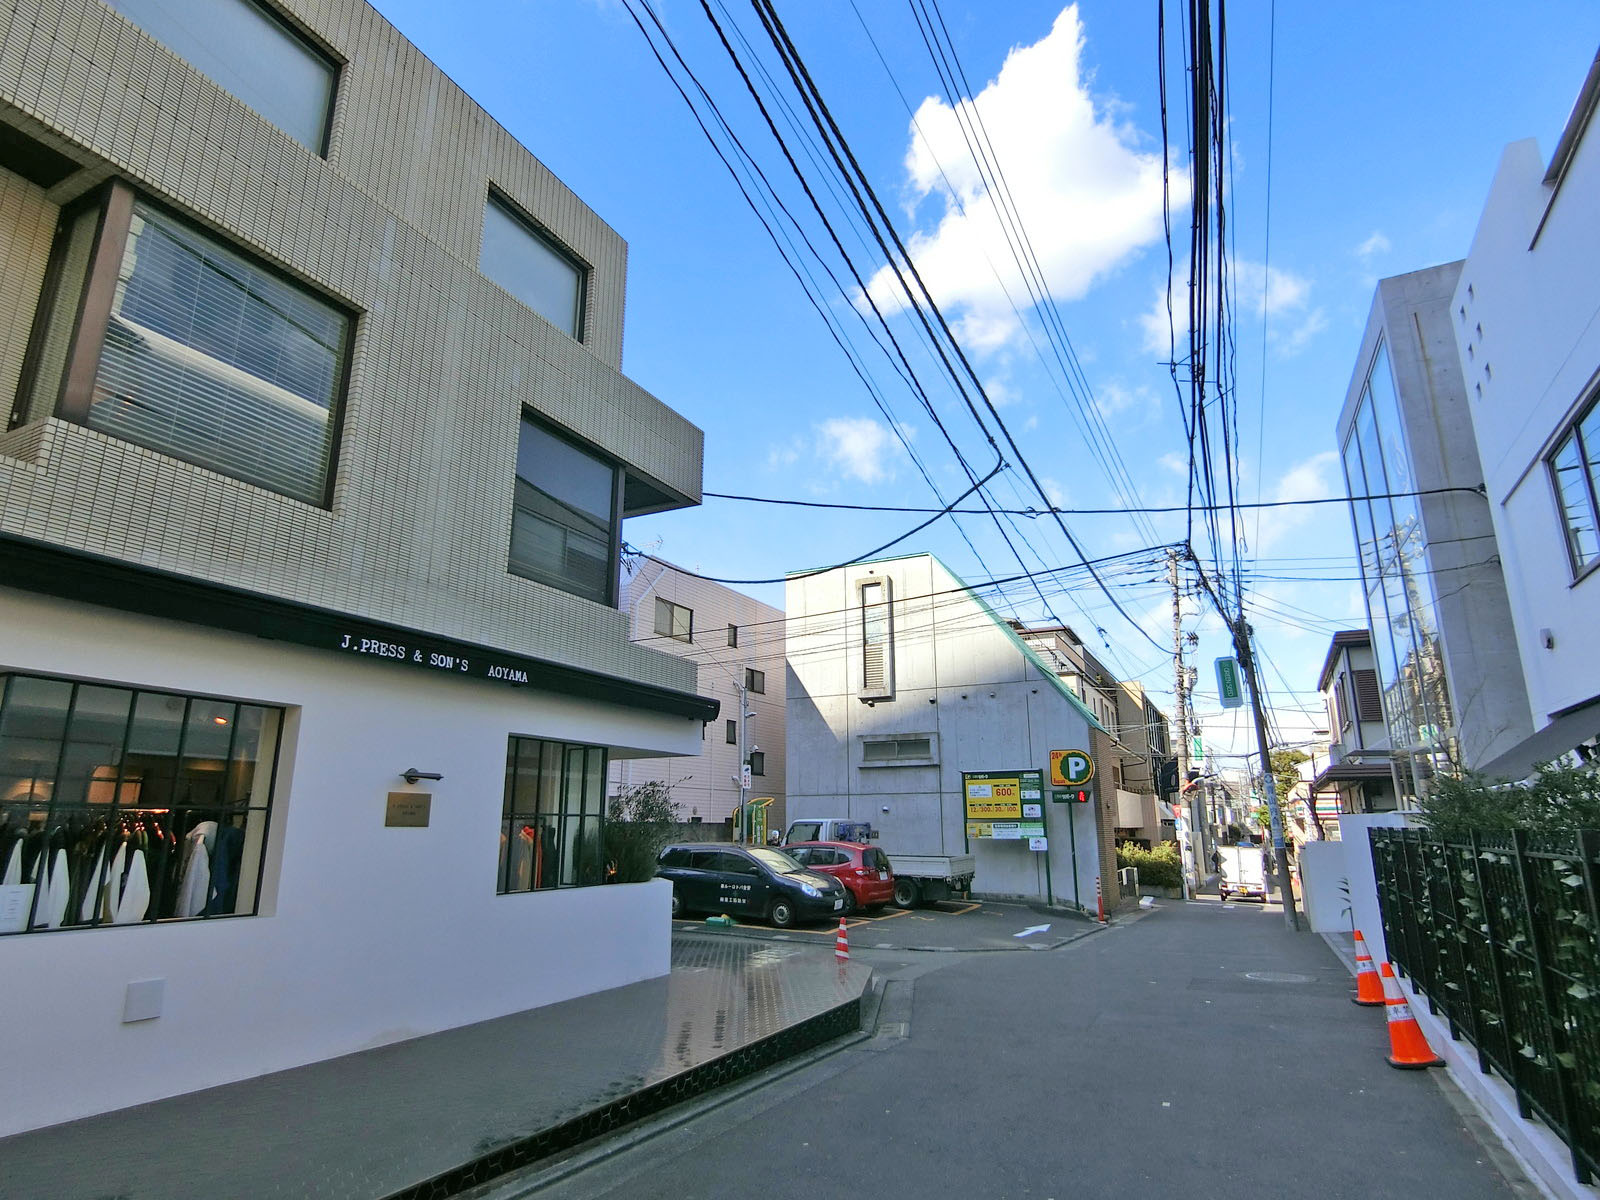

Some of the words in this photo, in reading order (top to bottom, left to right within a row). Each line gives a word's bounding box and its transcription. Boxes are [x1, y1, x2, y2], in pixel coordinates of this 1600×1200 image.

[341, 634, 406, 659] J.PRESS
[413, 649, 423, 663] &
[430, 653, 469, 672] SON'S
[487, 665, 528, 683] AOYAMA
[1068, 756, 1086, 779] P
